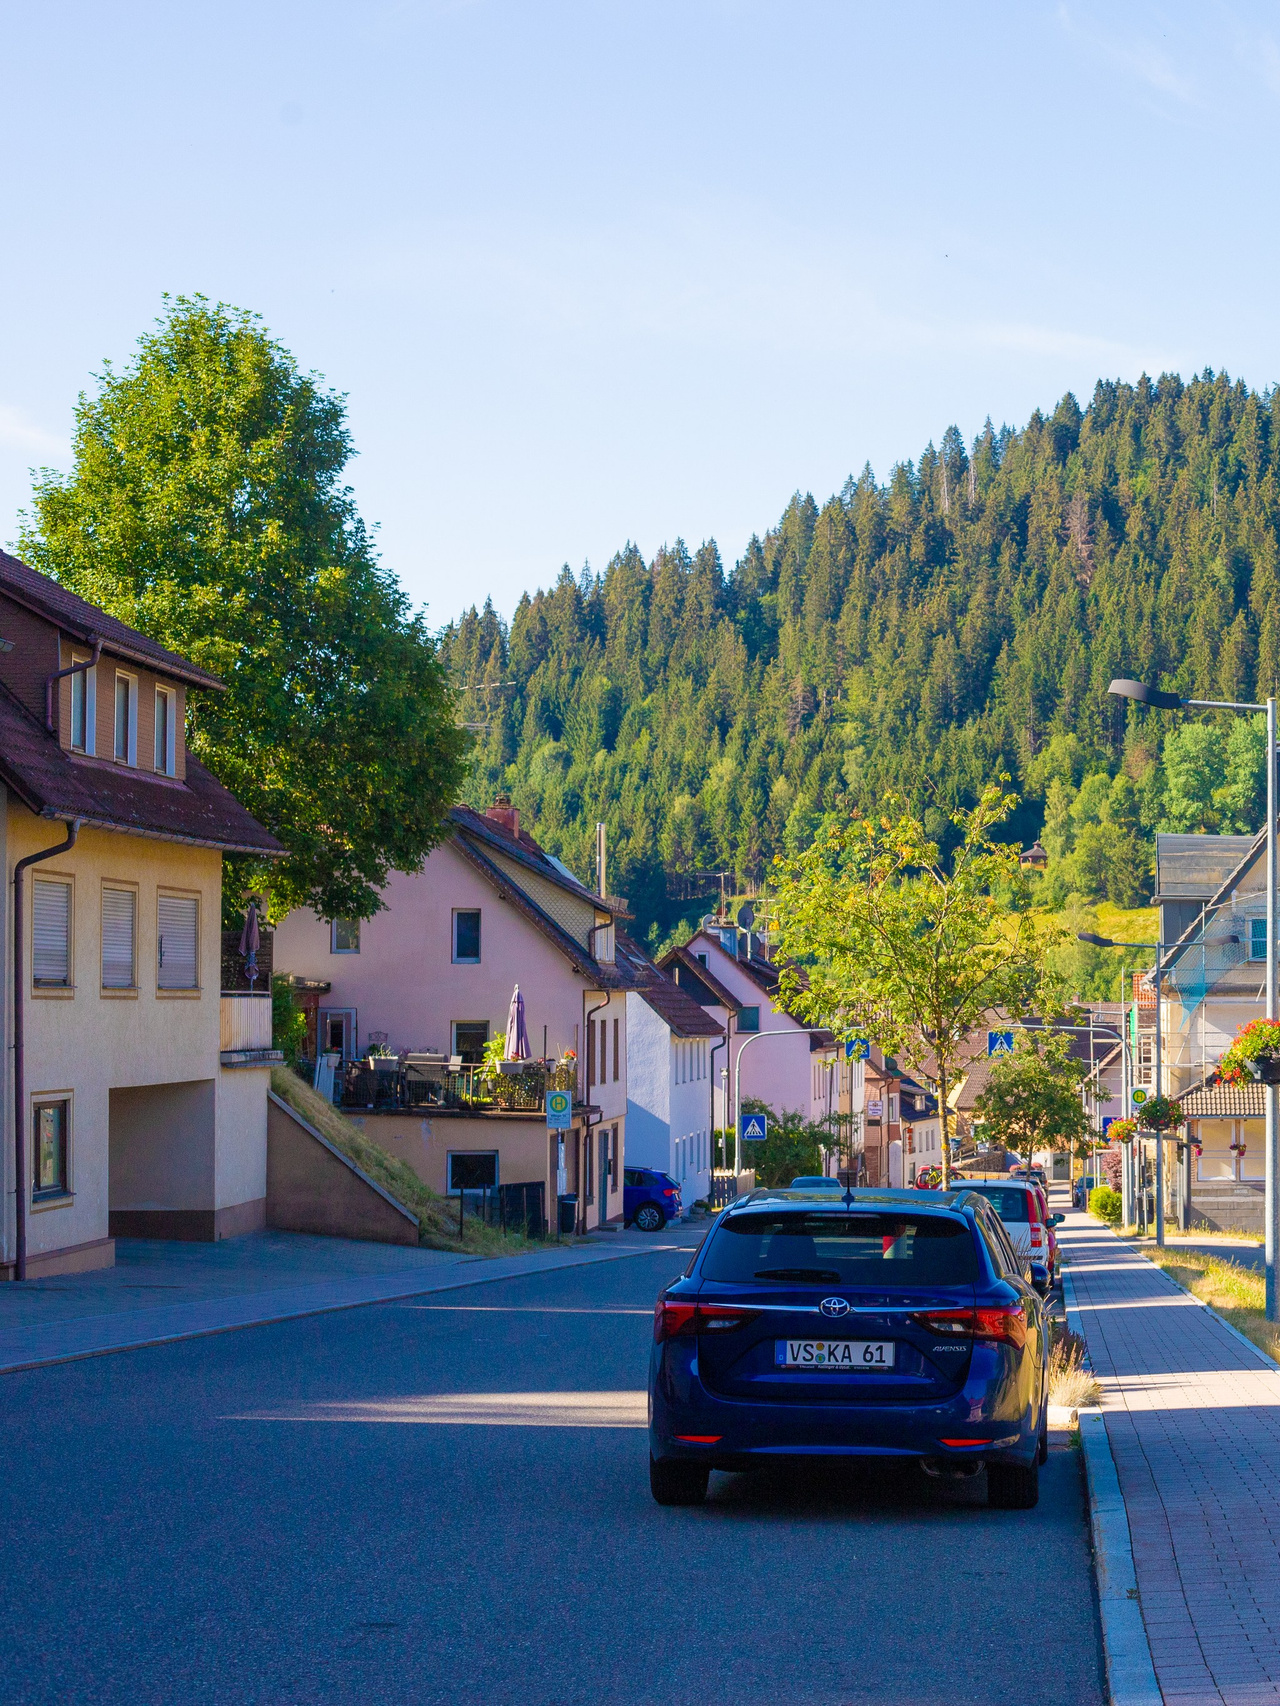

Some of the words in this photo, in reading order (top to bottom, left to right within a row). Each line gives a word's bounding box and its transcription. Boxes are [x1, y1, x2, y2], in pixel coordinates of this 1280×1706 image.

[790, 1343, 815, 1362] VS
[827, 1344, 852, 1363] KA
[862, 1344, 886, 1363] 61
